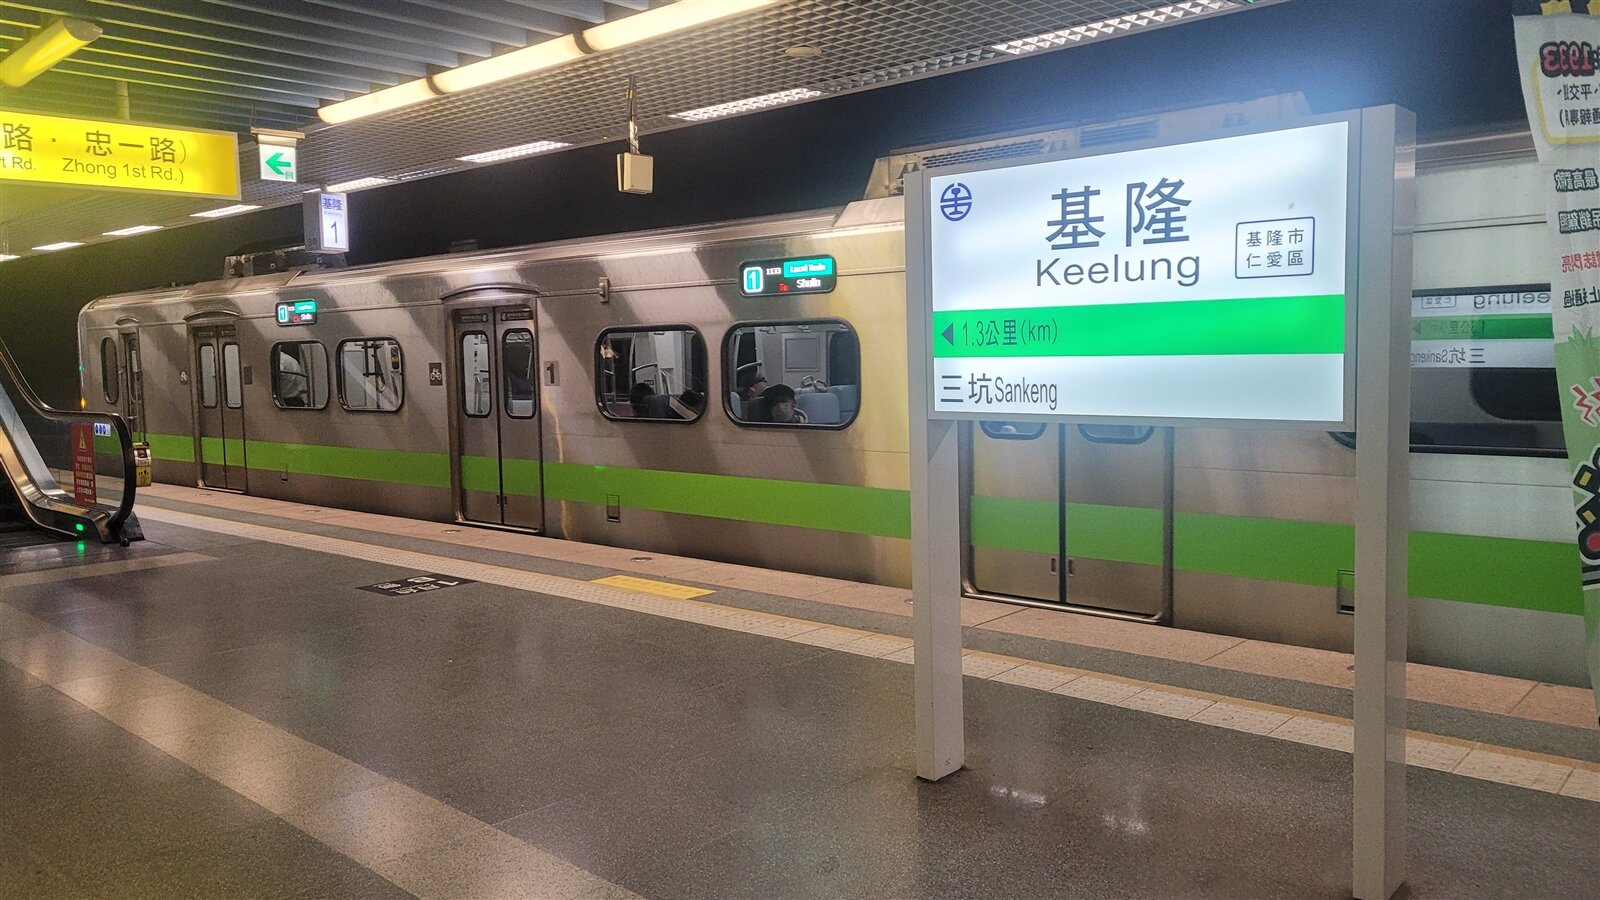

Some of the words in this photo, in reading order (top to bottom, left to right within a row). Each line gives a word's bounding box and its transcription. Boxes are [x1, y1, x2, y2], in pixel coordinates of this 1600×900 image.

[12, 156, 37, 170] Rd.
[62, 157, 117, 179] Zhong
[122, 163, 146, 178] 1st
[151, 166, 184, 184] Rd.)
[323, 198, 343, 211] 基隆
[1045, 178, 1192, 250] 基隆
[331, 220, 338, 244] 1
[1246, 228, 1304, 248] 基隆市
[789, 264, 808, 273] Local
[1246, 250, 1304, 269] 仁愛區
[1036, 254, 1200, 287] Keelung
[796, 278, 821, 288] Shulin
[546, 362, 555, 384] 1
